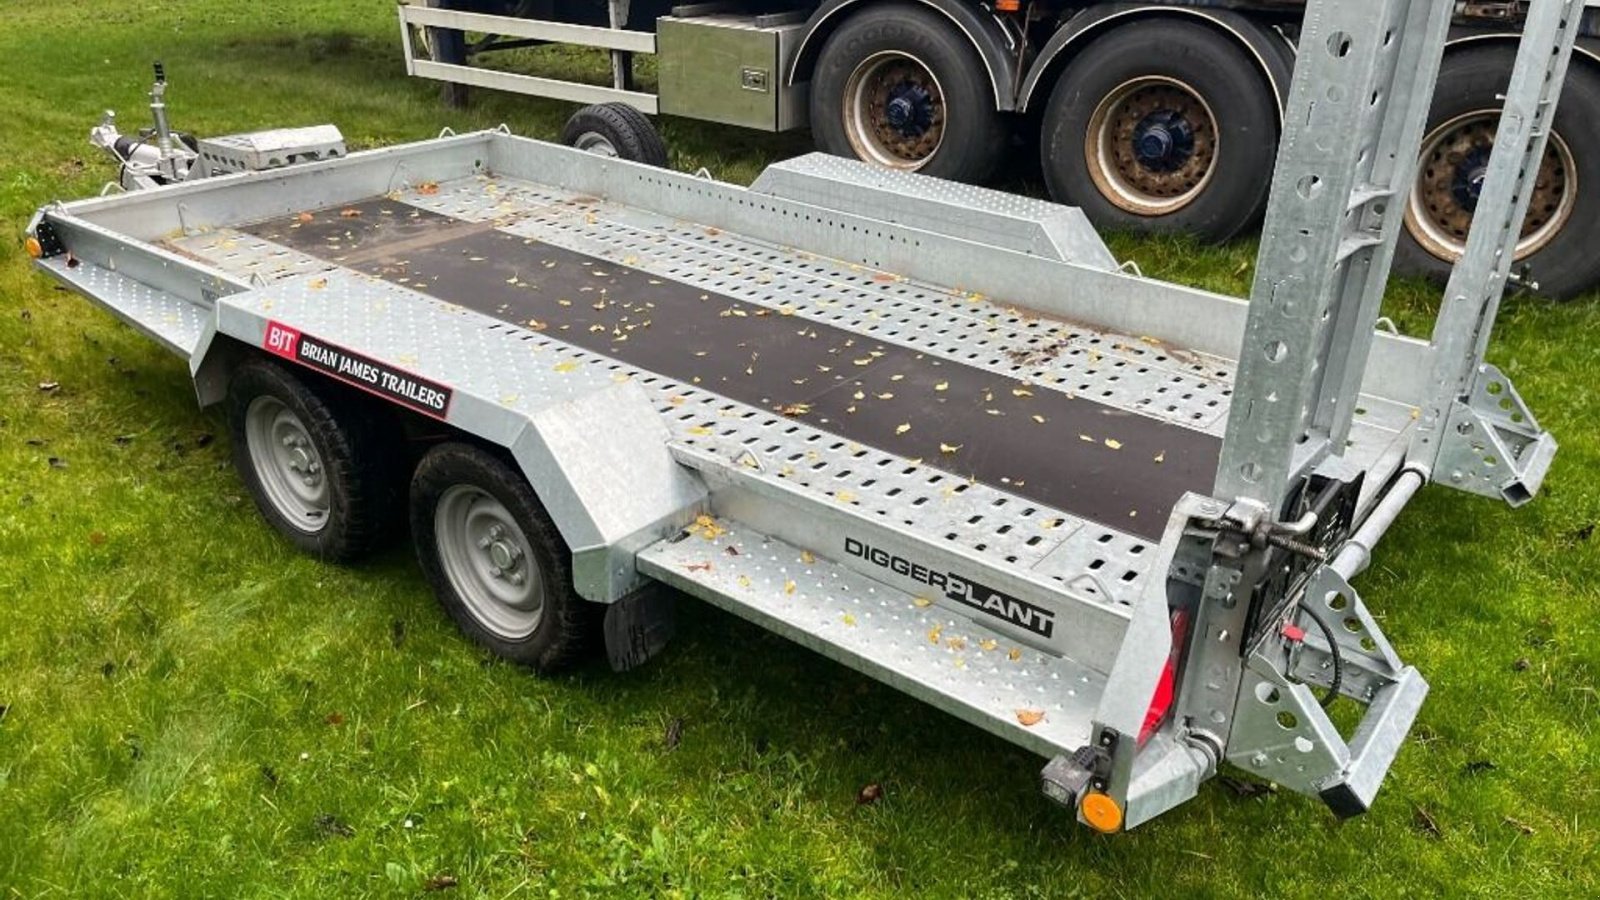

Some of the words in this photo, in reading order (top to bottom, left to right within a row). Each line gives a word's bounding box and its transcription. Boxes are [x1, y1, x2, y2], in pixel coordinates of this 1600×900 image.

[269, 326, 295, 352] BJT
[301, 341, 338, 368] BRIAN
[337, 356, 379, 384] JAMES
[381, 372, 446, 410] TRAILERS
